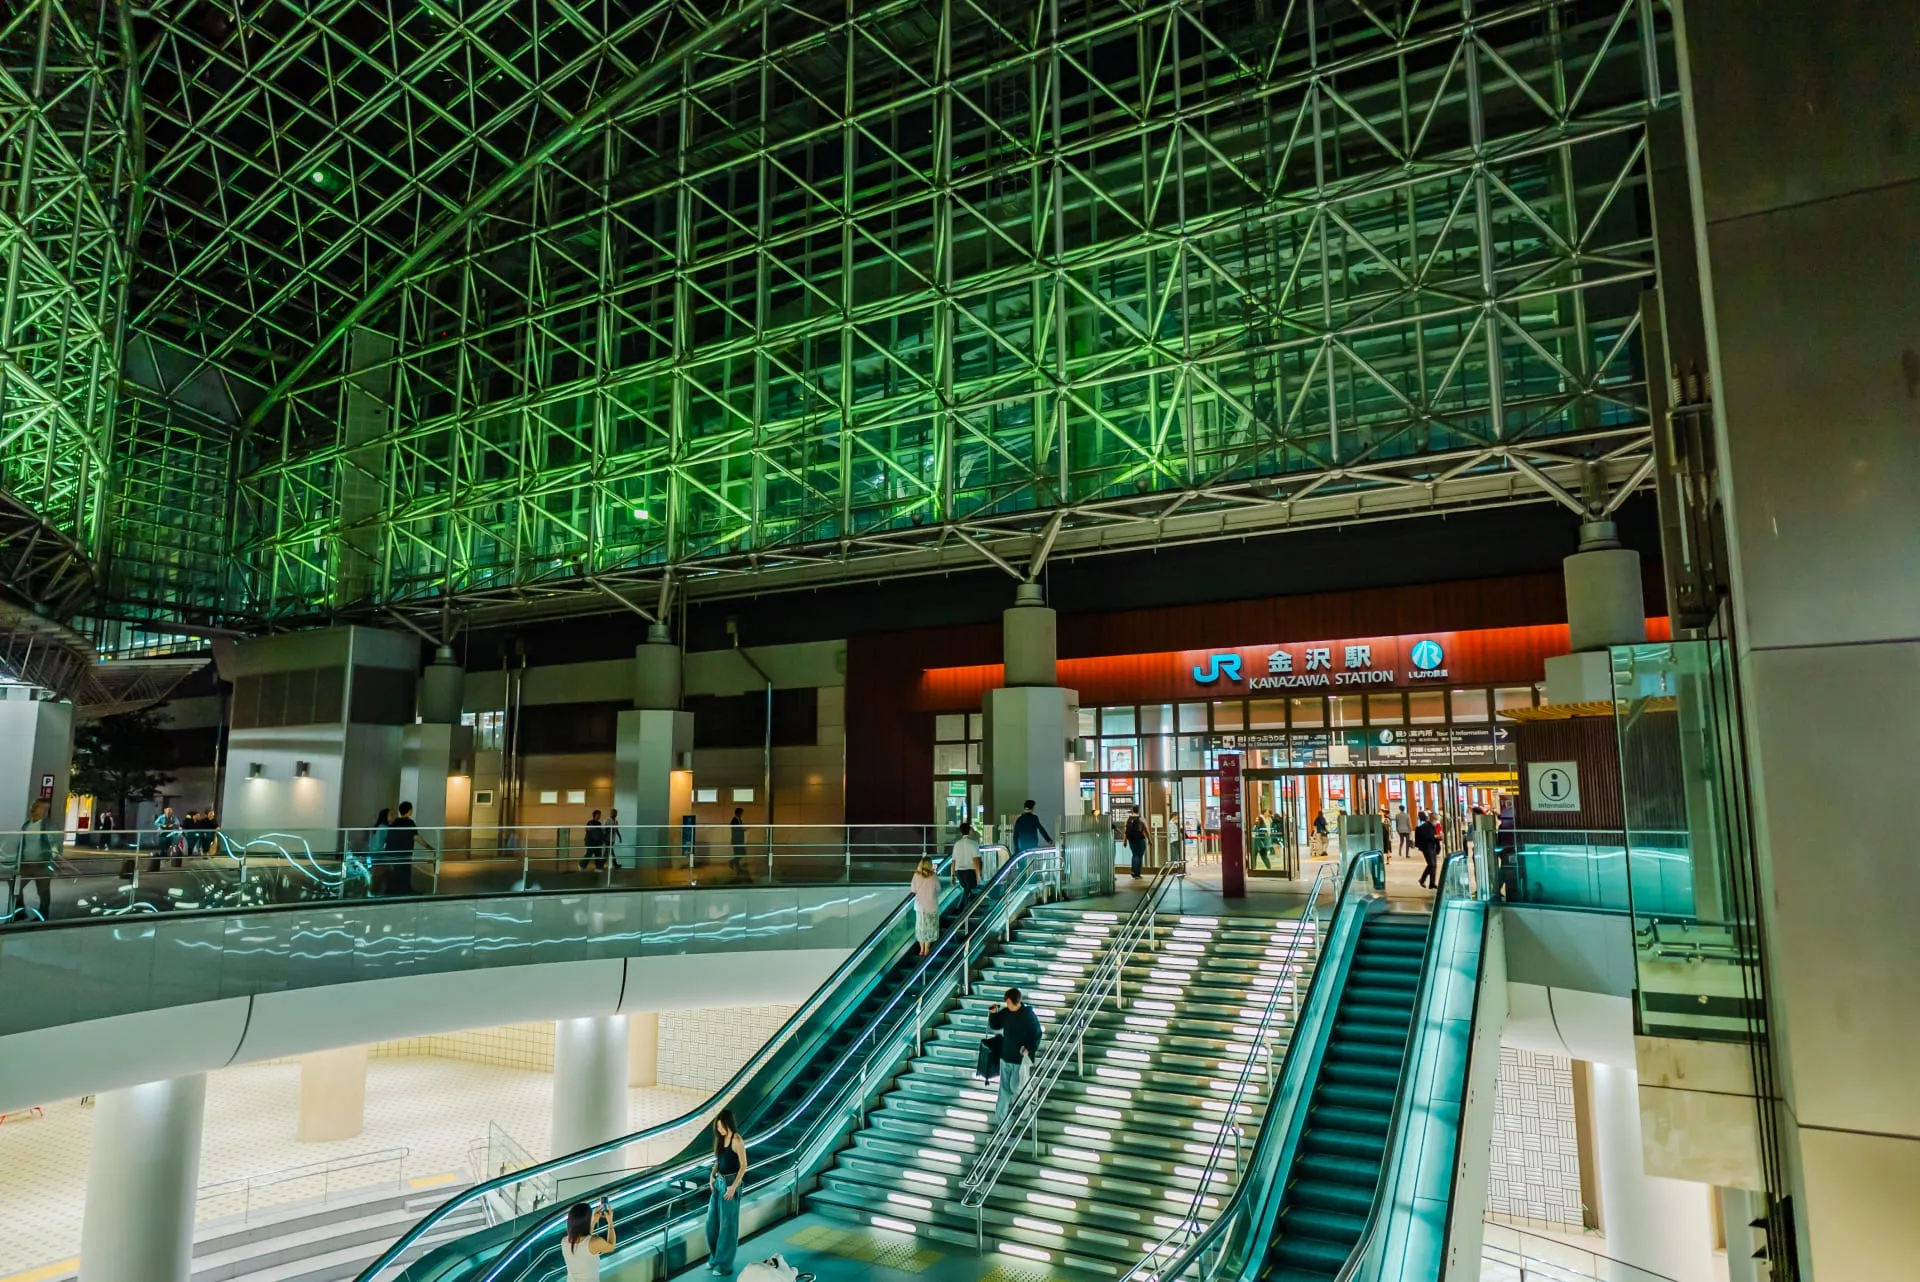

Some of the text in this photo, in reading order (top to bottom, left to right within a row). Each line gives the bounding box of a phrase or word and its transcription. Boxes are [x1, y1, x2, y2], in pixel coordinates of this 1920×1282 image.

[1193, 653, 1243, 683] JR
[1268, 645, 1372, 673] 金沢駅
[1249, 670, 1394, 690] KANAZAWA STATION
